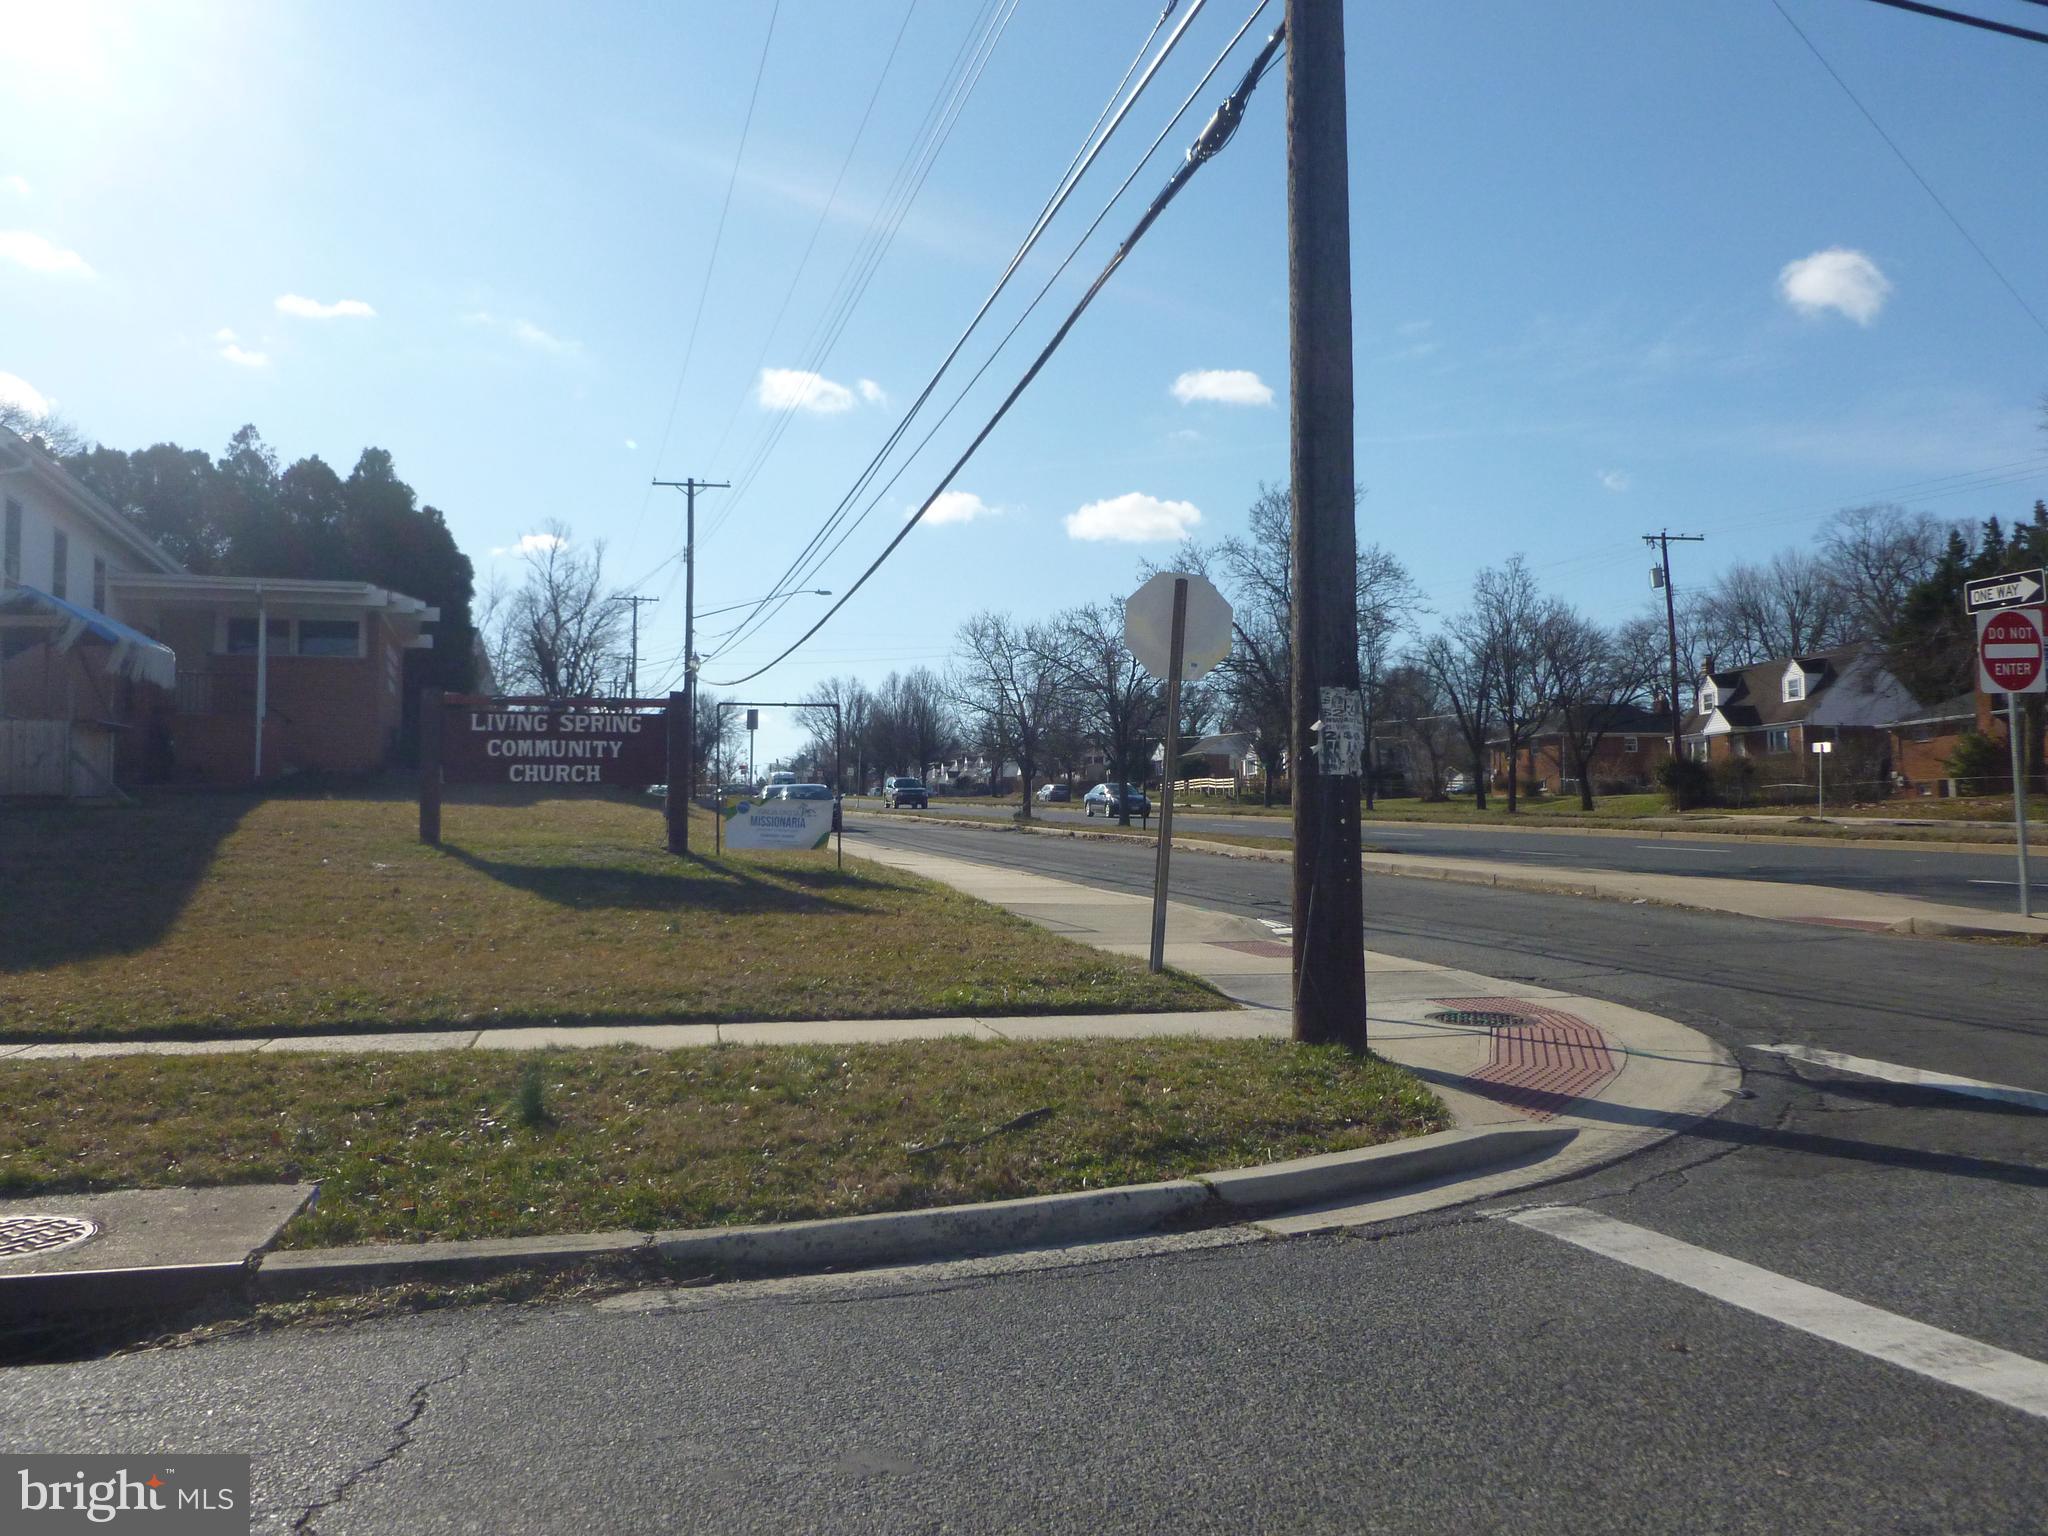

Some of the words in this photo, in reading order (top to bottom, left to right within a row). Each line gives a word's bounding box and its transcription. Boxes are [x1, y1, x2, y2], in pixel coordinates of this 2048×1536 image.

[1973, 588, 1993, 603] ONE
[1997, 583, 2019, 598] WAY
[1988, 627, 2005, 640] DO
[2010, 626, 2033, 639] NOT
[1995, 663, 2032, 676] ENTER
[471, 713, 548, 731] LIVING
[559, 714, 642, 733] SPRING
[487, 739, 623, 758] COMMUNITY
[509, 764, 601, 782] CHURCH
